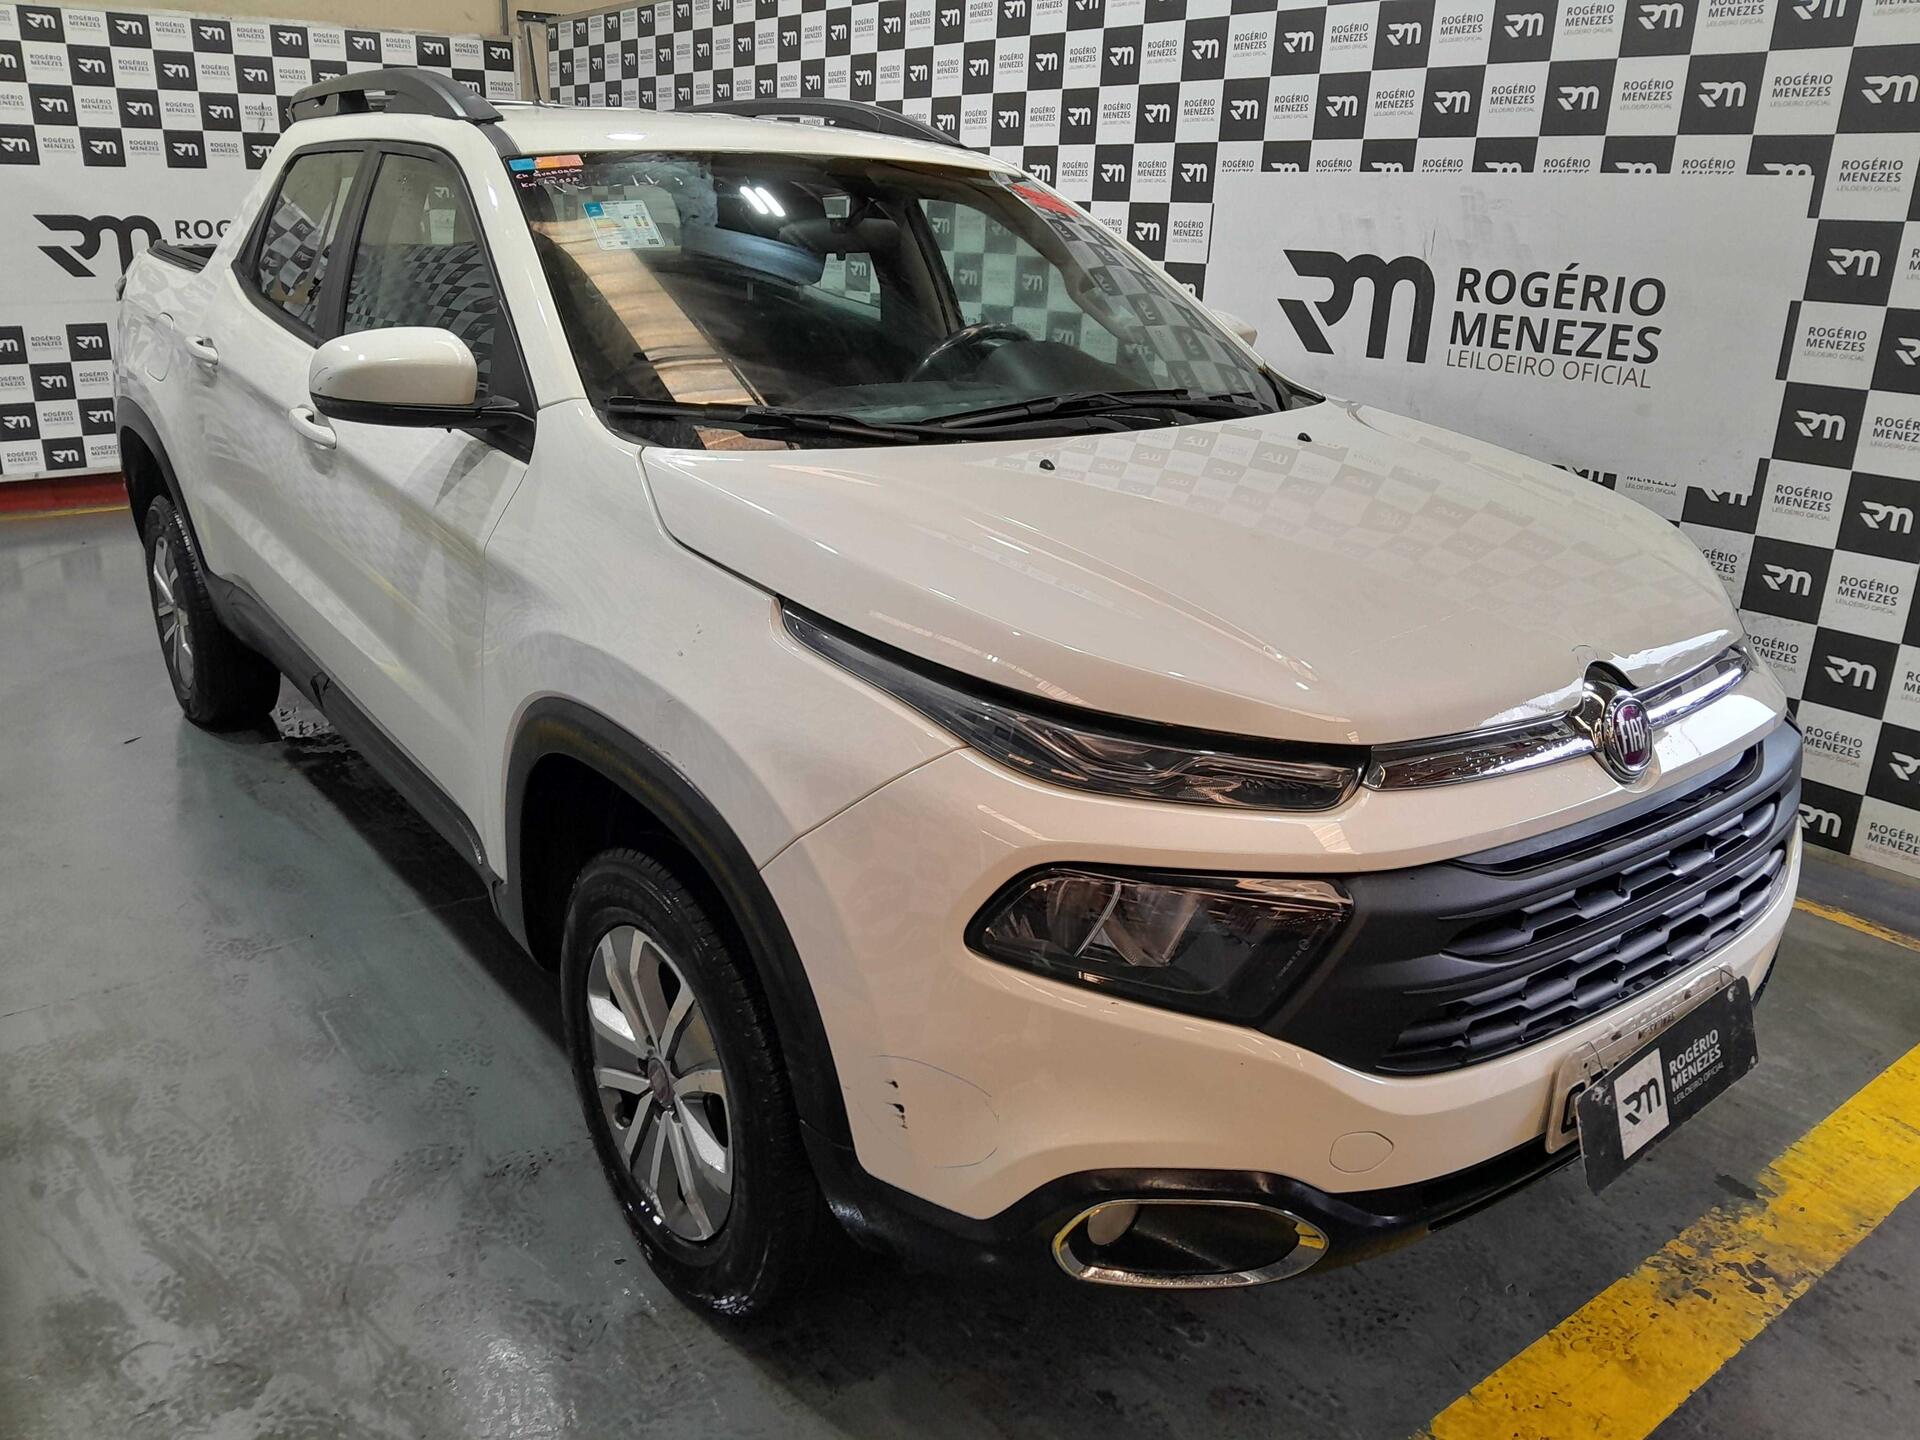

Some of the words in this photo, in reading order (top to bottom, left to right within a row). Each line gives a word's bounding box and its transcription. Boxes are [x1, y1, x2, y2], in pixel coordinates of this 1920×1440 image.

[1567, 3, 1615, 16] ROGÉRIO
[1708, 4, 1764, 17] MENEZES
[68, 14, 100, 25] ROGÉRIO
[1441, 13, 1483, 25] ROGÉRIO
[1565, 13, 1614, 26] MENEZES
[1332, 22, 1369, 35] ROGÉRIO
[1440, 24, 1482, 36] MENEZES
[1234, 31, 1267, 43] ROGÉRIO
[1330, 32, 1368, 43] MENEZES
[1233, 40, 1267, 51] MENEZES
[1623, 79, 1673, 91] ROGÉRIO
[1774, 73, 1833, 88] ROGÉRIO
[1376, 88, 1415, 101] ROGÉRIO
[1491, 84, 1536, 95] ROGÉRIO
[1622, 90, 1672, 101] MENEZES
[1772, 85, 1831, 99] MENEZES
[1275, 93, 1309, 105] ROGÉRIO
[1375, 98, 1414, 110] MENEZES
[1490, 94, 1535, 105] MENEZES
[1183, 107, 1215, 117] MENEZES
[1274, 102, 1308, 113] MENEZES
[1222, 157, 1254, 171] ROGÉRIO
[1316, 157, 1352, 171] ROGÉRIO
[1422, 157, 1463, 171] ROGÉRIO
[1544, 157, 1590, 169] ROGÉRIO
[1683, 157, 1735, 171] ROGÉRIO
[1841, 158, 1903, 172] ROGÉRIO
[1839, 171, 1901, 184] MENEZES
[1454, 263, 1665, 319] ROGÉRIO
[1447, 307, 1662, 367] MENEZES
[1808, 326, 1867, 341] ROGÉRIO
[1806, 338, 1865, 353] MENEZES
[1446, 349, 1555, 377] LEILOEIRO
[1562, 361, 1652, 389] OFICIAL
[1875, 416, 1920, 430] ROGÉR
[1873, 428, 1920, 443] MENEZ
[1775, 484, 1832, 501] ROGÉRIO
[1774, 495, 1832, 513] MENEZES
[1703, 548, 1737, 563] GÉRIO
[1839, 575, 1899, 594] ROGÉRIO
[1838, 586, 1898, 606] MENEZES
[1753, 646, 1797, 664] ENEZES
[1621, 715, 1646, 753] FIAT
[1805, 726, 1863, 748] ROGÉRIO
[1802, 736, 1862, 759] MENEZES
[1869, 822, 1920, 844] ROGÉRI
[1868, 832, 1920, 855] MENEZE
[1669, 1029, 1719, 1075] ROGÉRIO
[1671, 1044, 1721, 1092] MENEZES
